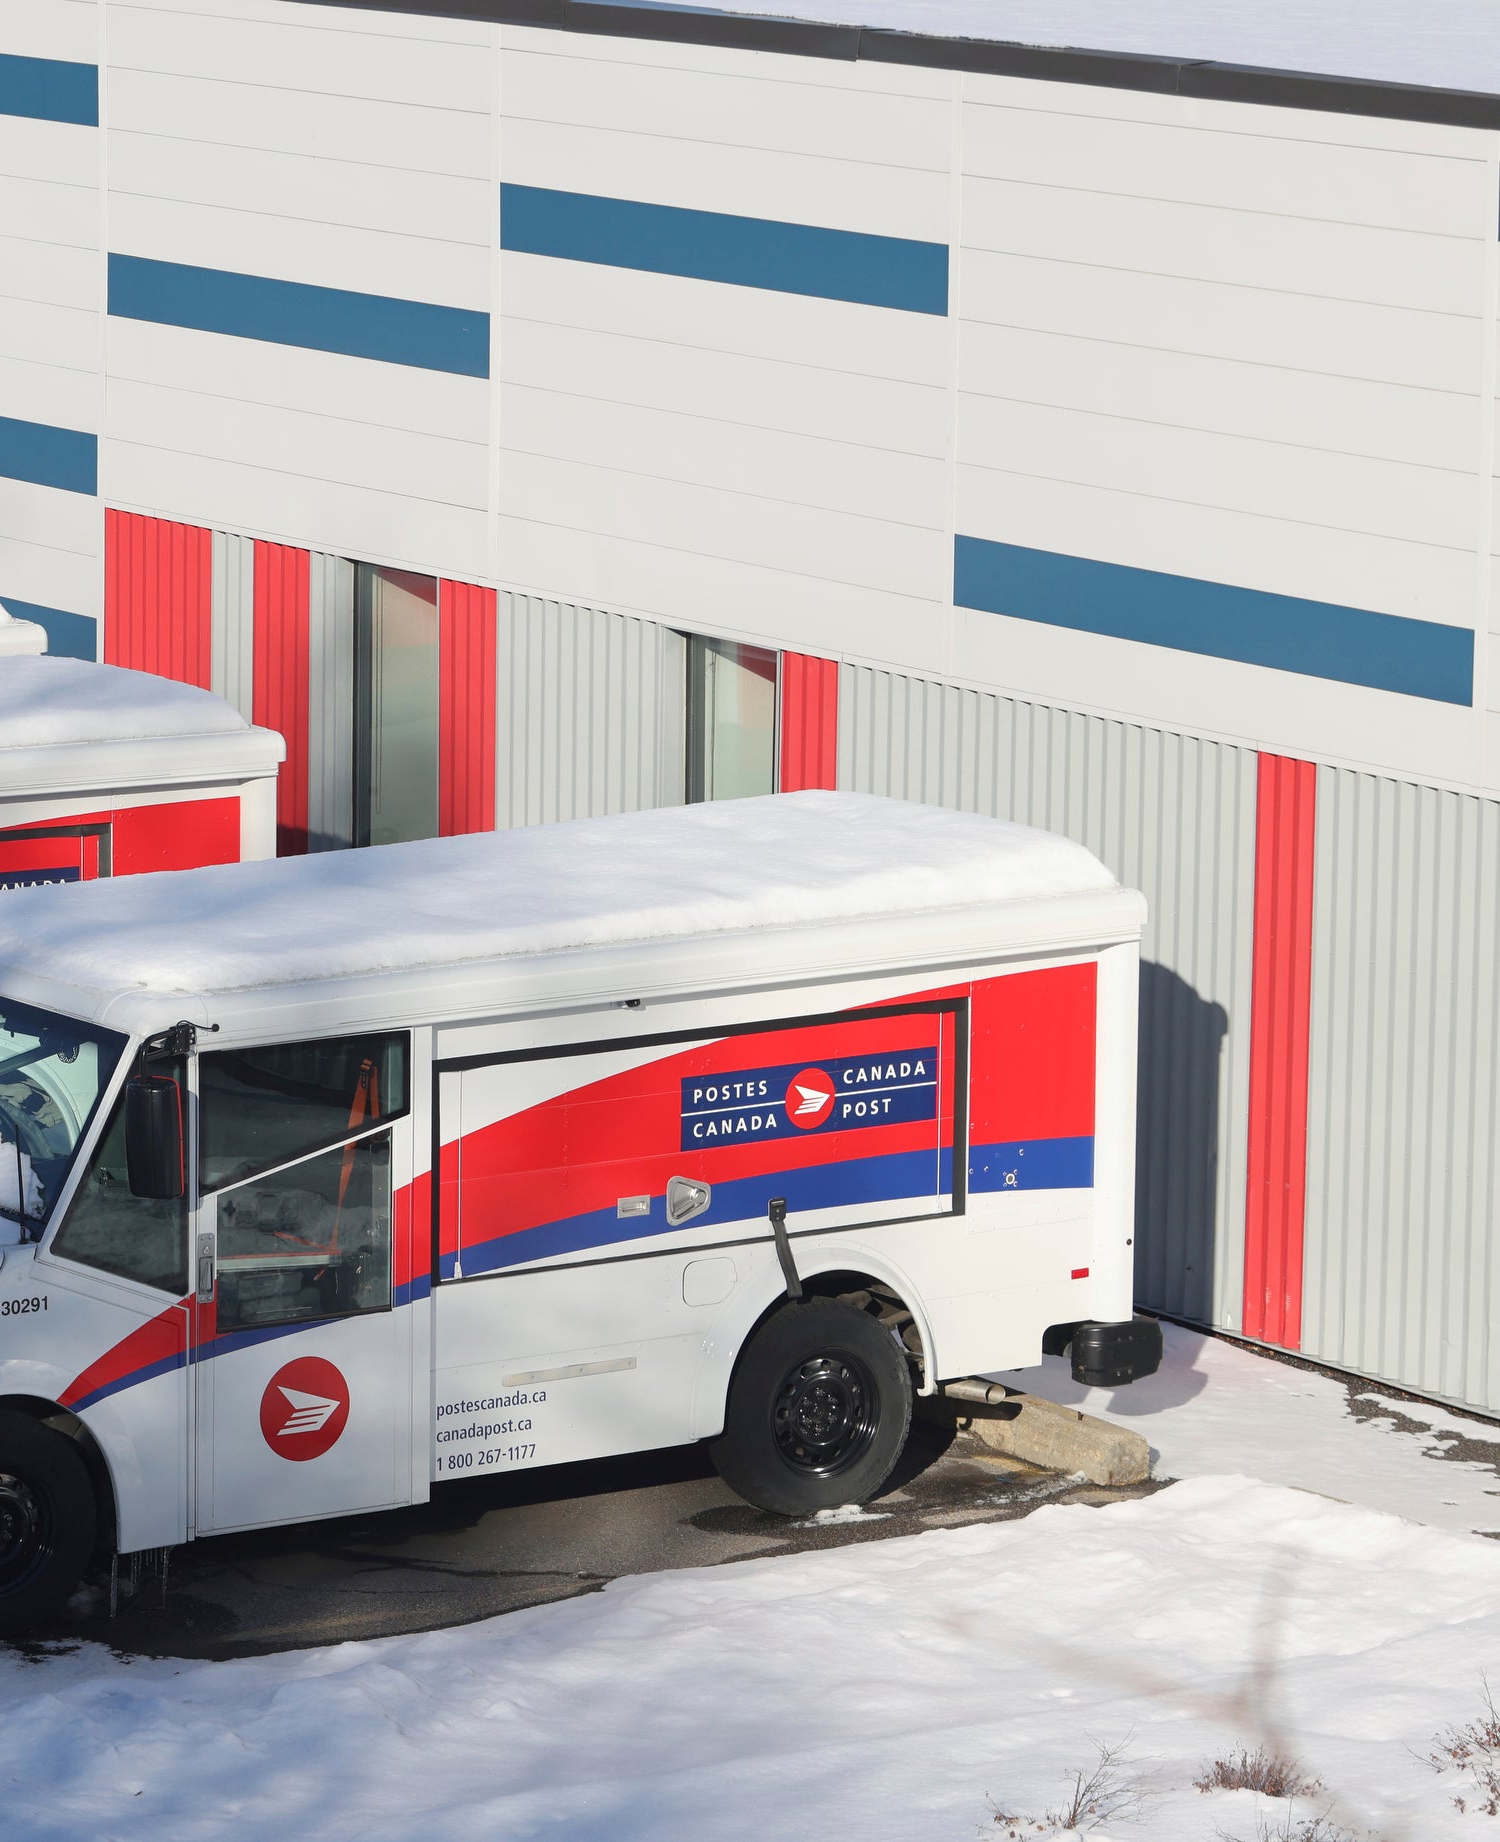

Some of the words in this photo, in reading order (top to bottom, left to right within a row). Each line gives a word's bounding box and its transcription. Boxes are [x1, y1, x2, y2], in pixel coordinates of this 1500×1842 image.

[843, 1061, 926, 1085] CANADA
[693, 1080, 768, 1104] POSTES
[842, 1098, 892, 1119] POST
[693, 1113, 778, 1138] CANADA
[436, 1390, 547, 1421] postescanada.ca
[436, 1419, 532, 1442] canadapost.ca
[436, 1457, 442, 1471] 1
[448, 1452, 473, 1469] 800
[478, 1443, 536, 1466] 267-1177
